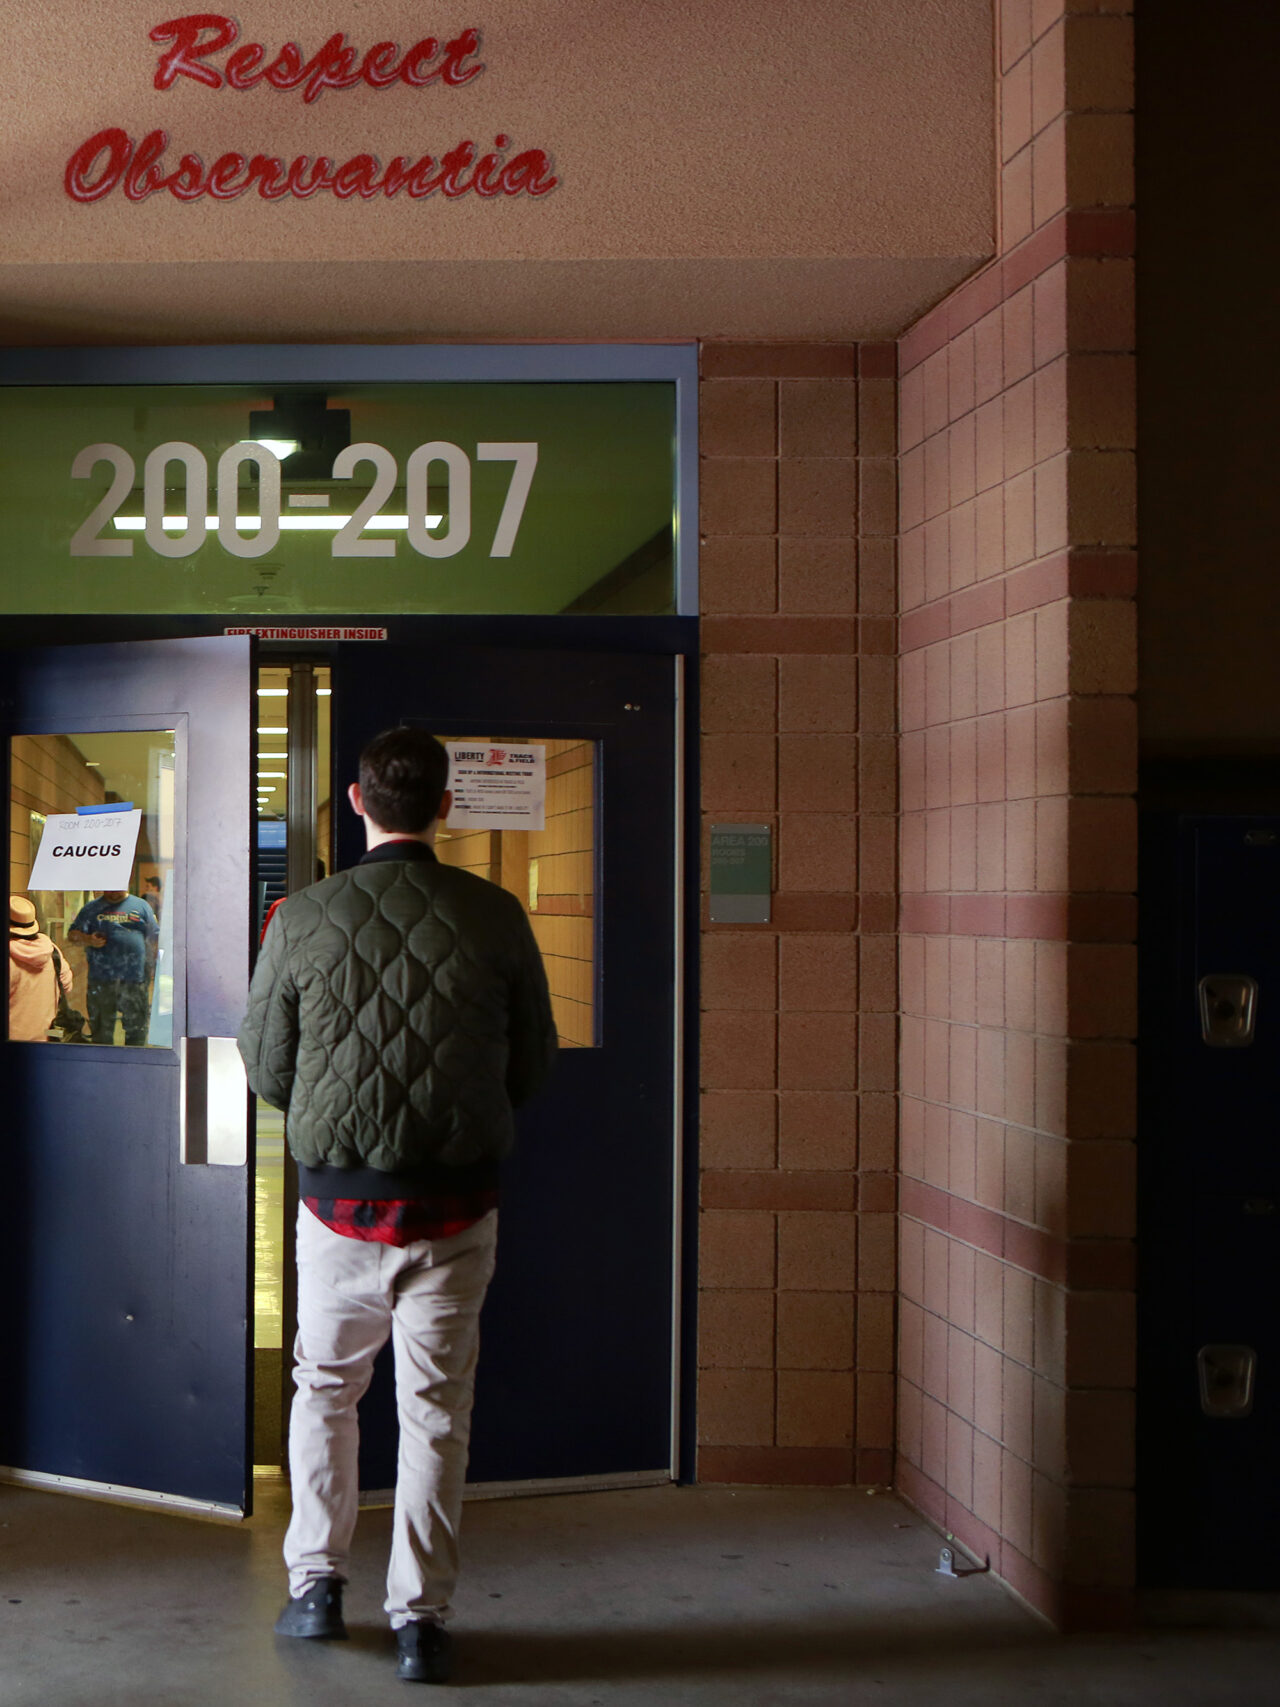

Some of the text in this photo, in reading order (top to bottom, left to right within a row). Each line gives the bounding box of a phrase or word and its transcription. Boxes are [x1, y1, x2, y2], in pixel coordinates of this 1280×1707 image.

[150, 13, 484, 103] Respect
[64, 127, 558, 203] Observantia
[70, 441, 539, 558] 200-207
[256, 629, 341, 640] EXTINGUISHER
[344, 629, 384, 640] INSIDE
[454, 751, 485, 760] LIBERTY
[712, 835, 746, 846] AREA
[52, 845, 121, 857] CAUCUS
